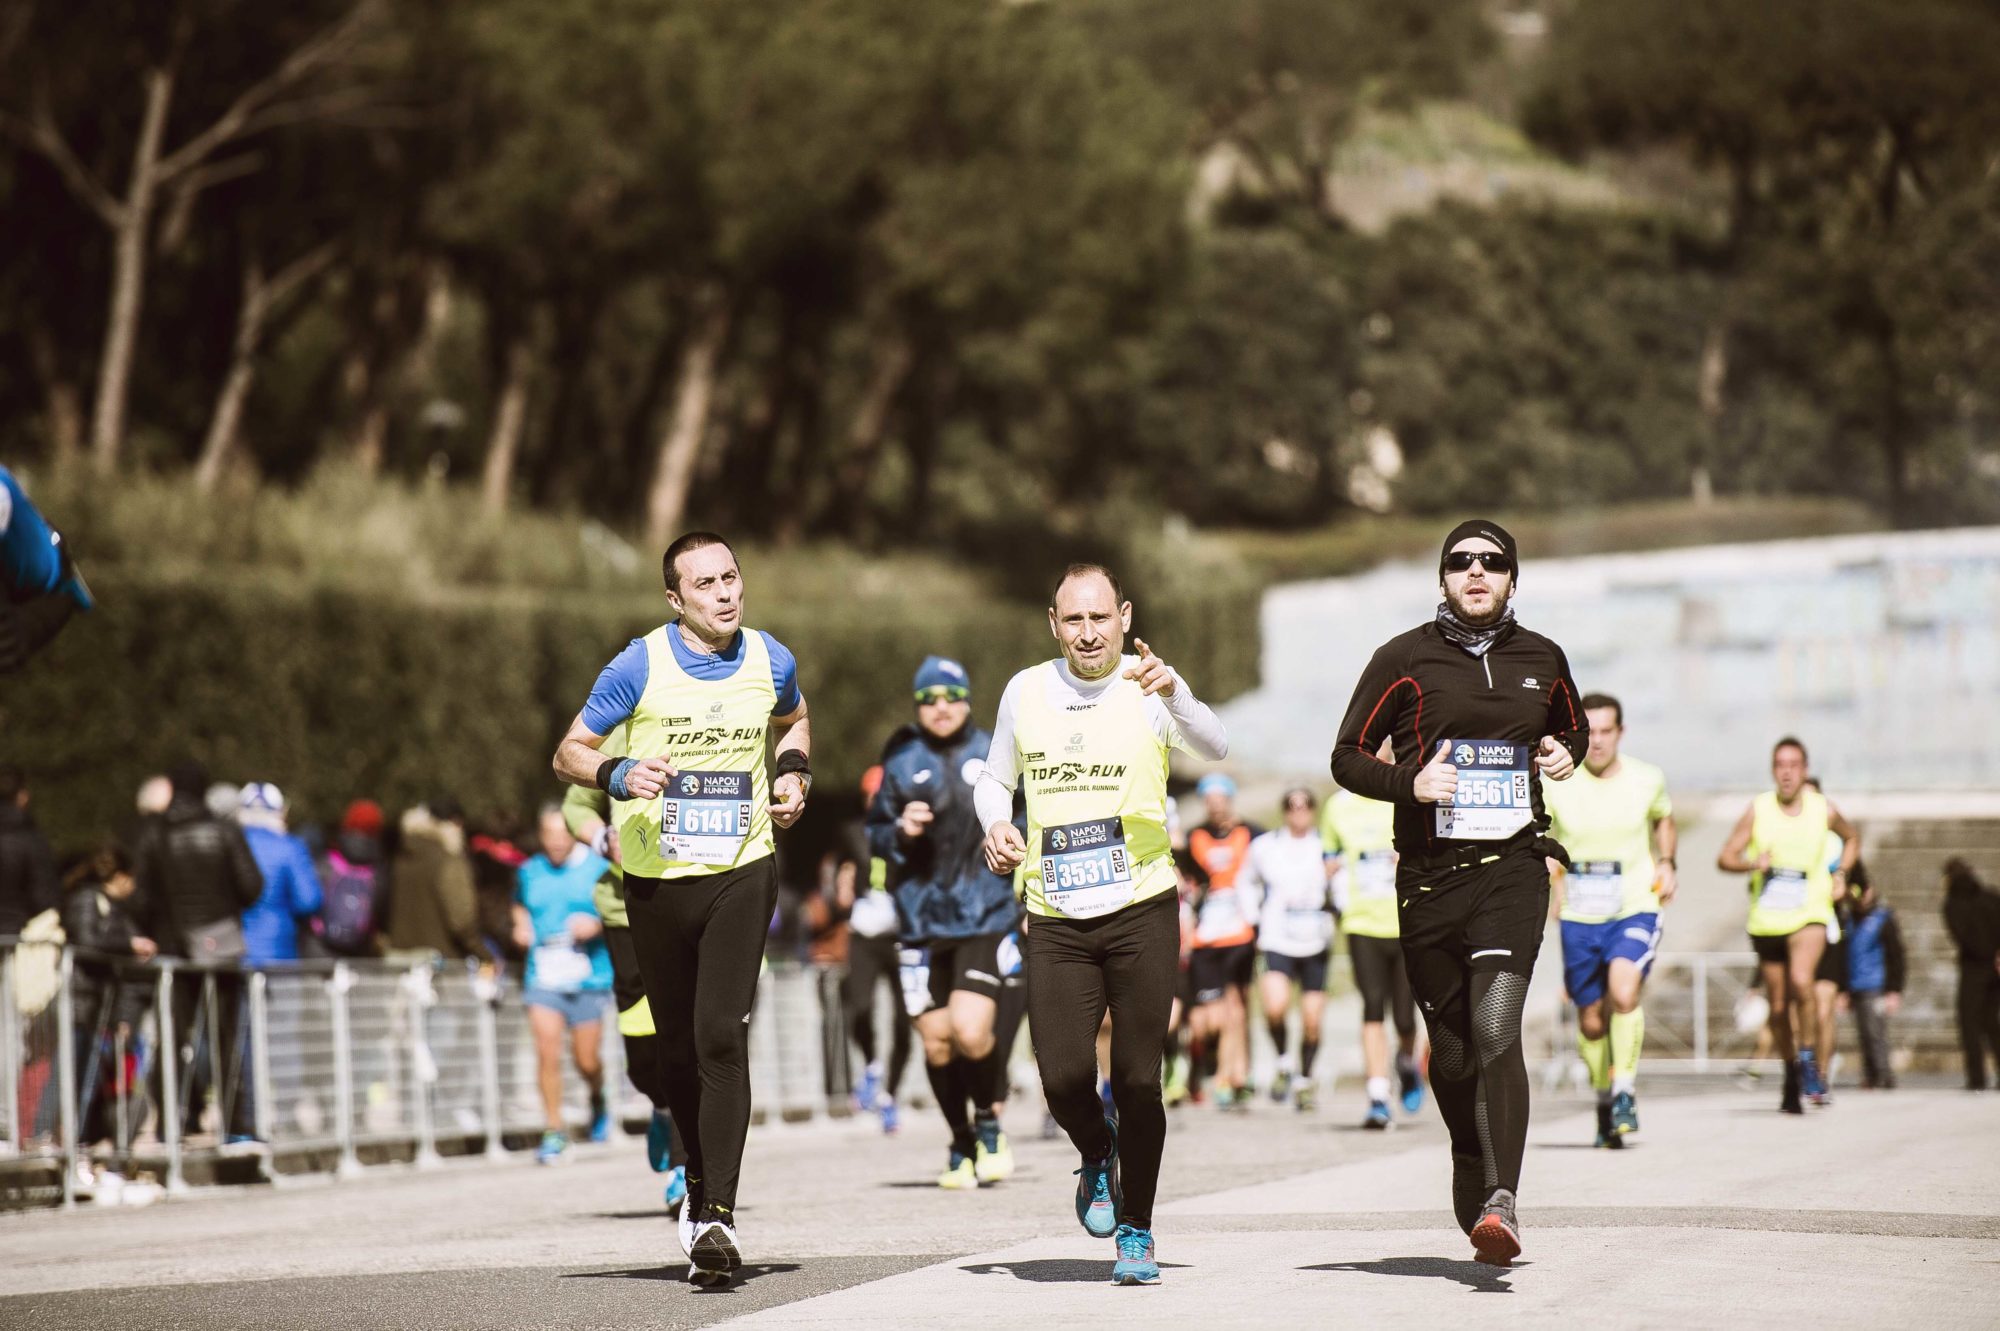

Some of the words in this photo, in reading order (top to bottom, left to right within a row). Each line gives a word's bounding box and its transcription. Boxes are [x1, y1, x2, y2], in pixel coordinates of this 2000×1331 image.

[666, 732, 704, 745] TOP
[731, 727, 762, 740] RUN
[680, 749, 718, 757] SPECIALISTA
[1478, 746, 1514, 755] NAPOLI
[1478, 757, 1513, 765] RUNNING
[1031, 766, 1060, 781] TOP
[1088, 764, 1127, 778] RUN
[703, 776, 740, 786] NAPOLI
[703, 787, 739, 795] RUNNING
[1042, 785, 1078, 794] SPECIALISTA
[1457, 780, 1511, 805] 5561
[684, 808, 733, 833] 6141
[1070, 823, 1106, 838] NAPOLI
[1071, 834, 1107, 847] RUNNING
[1058, 857, 1111, 888] 3531
